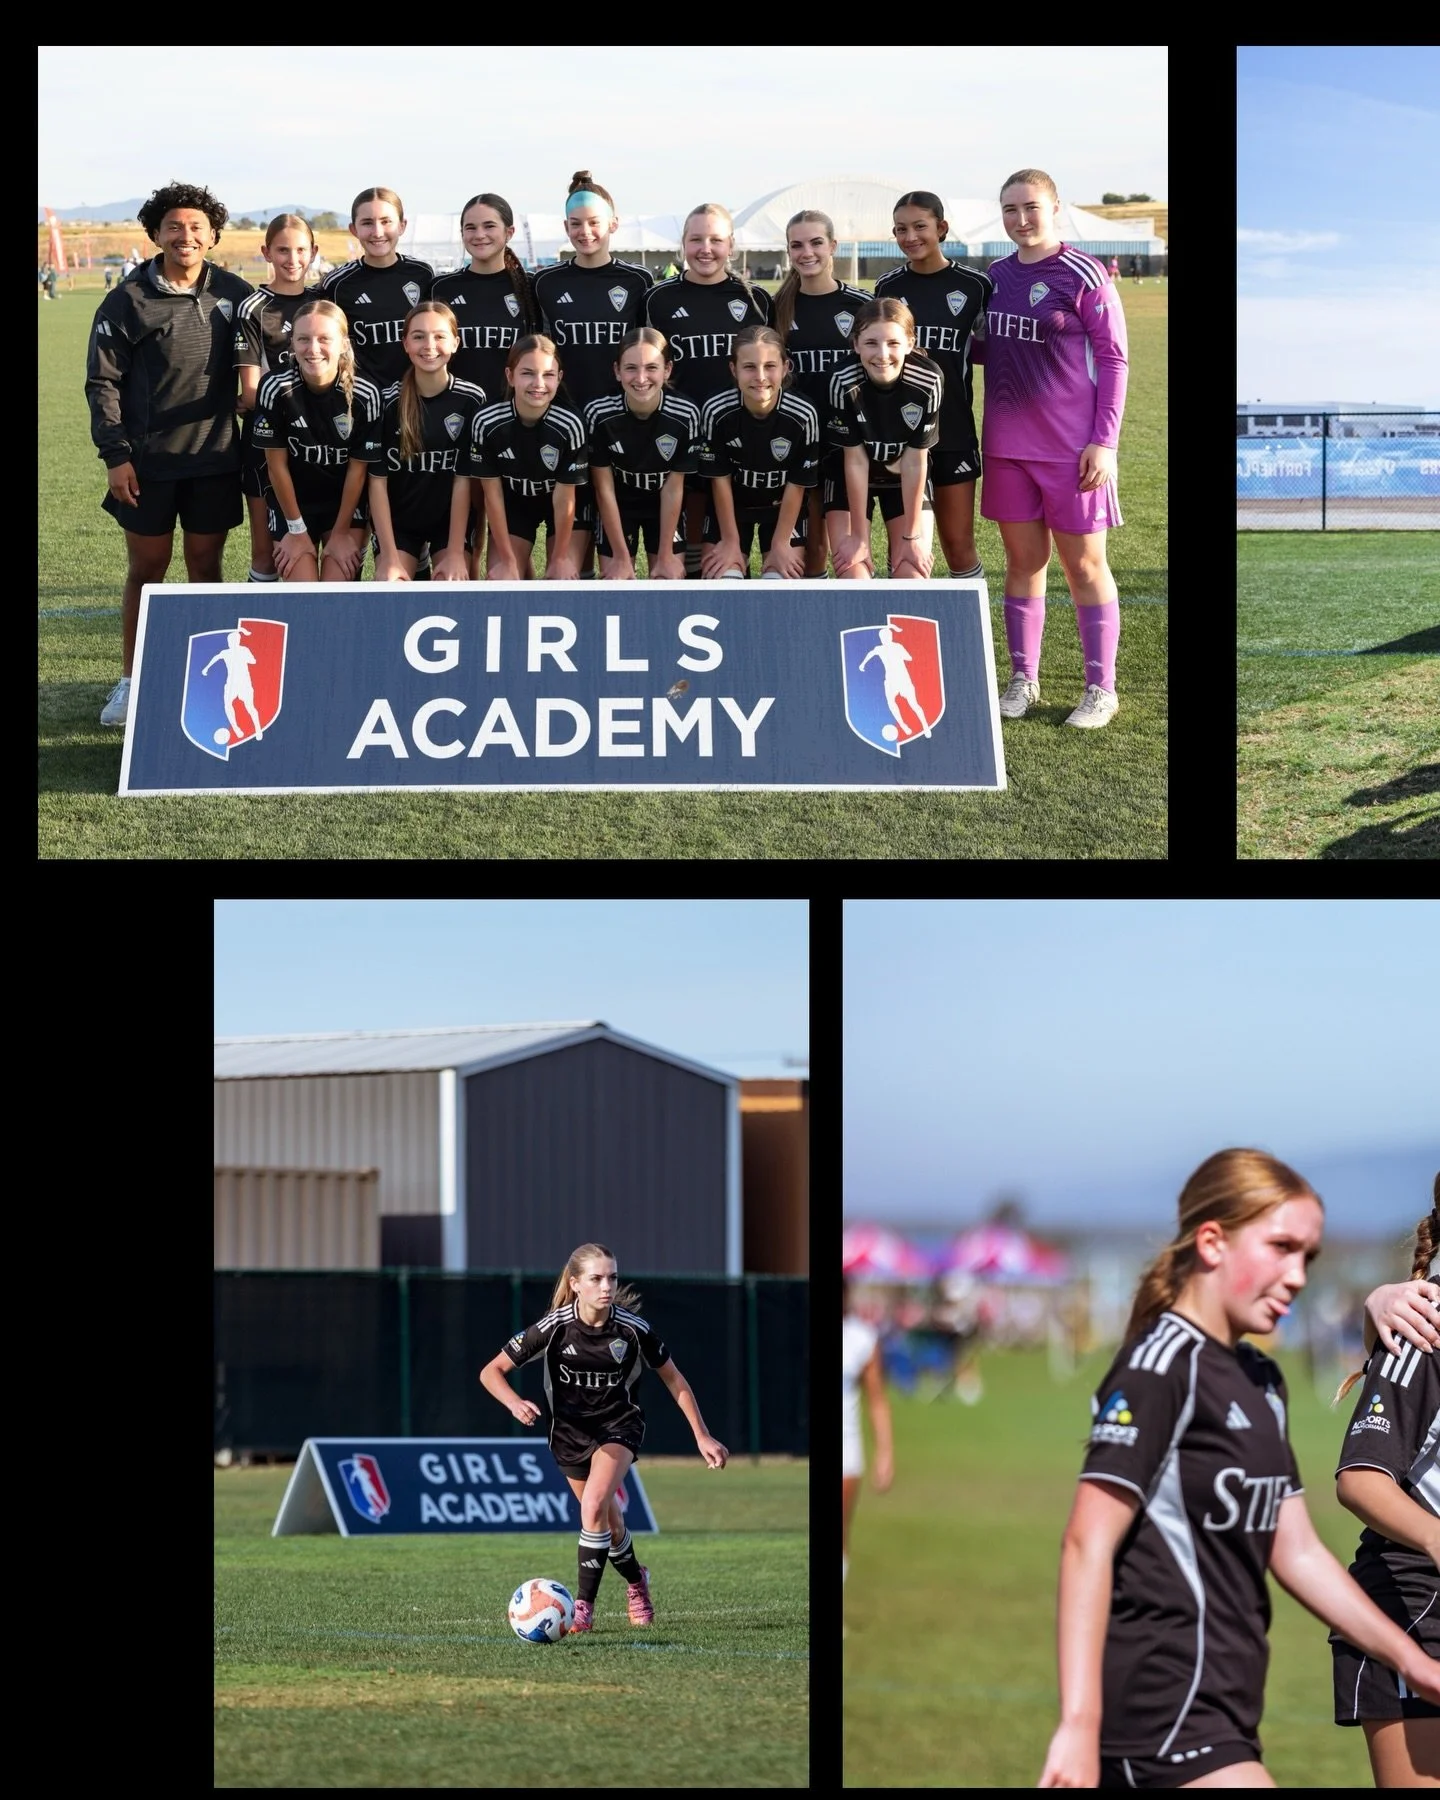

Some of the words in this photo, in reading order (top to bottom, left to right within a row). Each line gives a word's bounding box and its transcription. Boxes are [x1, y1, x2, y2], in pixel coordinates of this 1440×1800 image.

[353, 319, 406, 346] STIF
[457, 326, 520, 349] TIFE
[914, 325, 961, 353] IFEL
[987, 311, 1046, 343] TIFEL
[669, 333, 739, 361] STIFE
[287, 436, 350, 466] STIFE
[501, 474, 557, 497] TIFE
[612, 462, 671, 490] TIFE
[403, 614, 724, 674] GIRLS
[346, 697, 776, 759] ACADEMY
[559, 1363, 624, 1388] STIFE
[419, 1453, 544, 1484] GIRLS
[420, 1492, 571, 1525] ACADEMY
[1202, 1466, 1292, 1533] STIF
